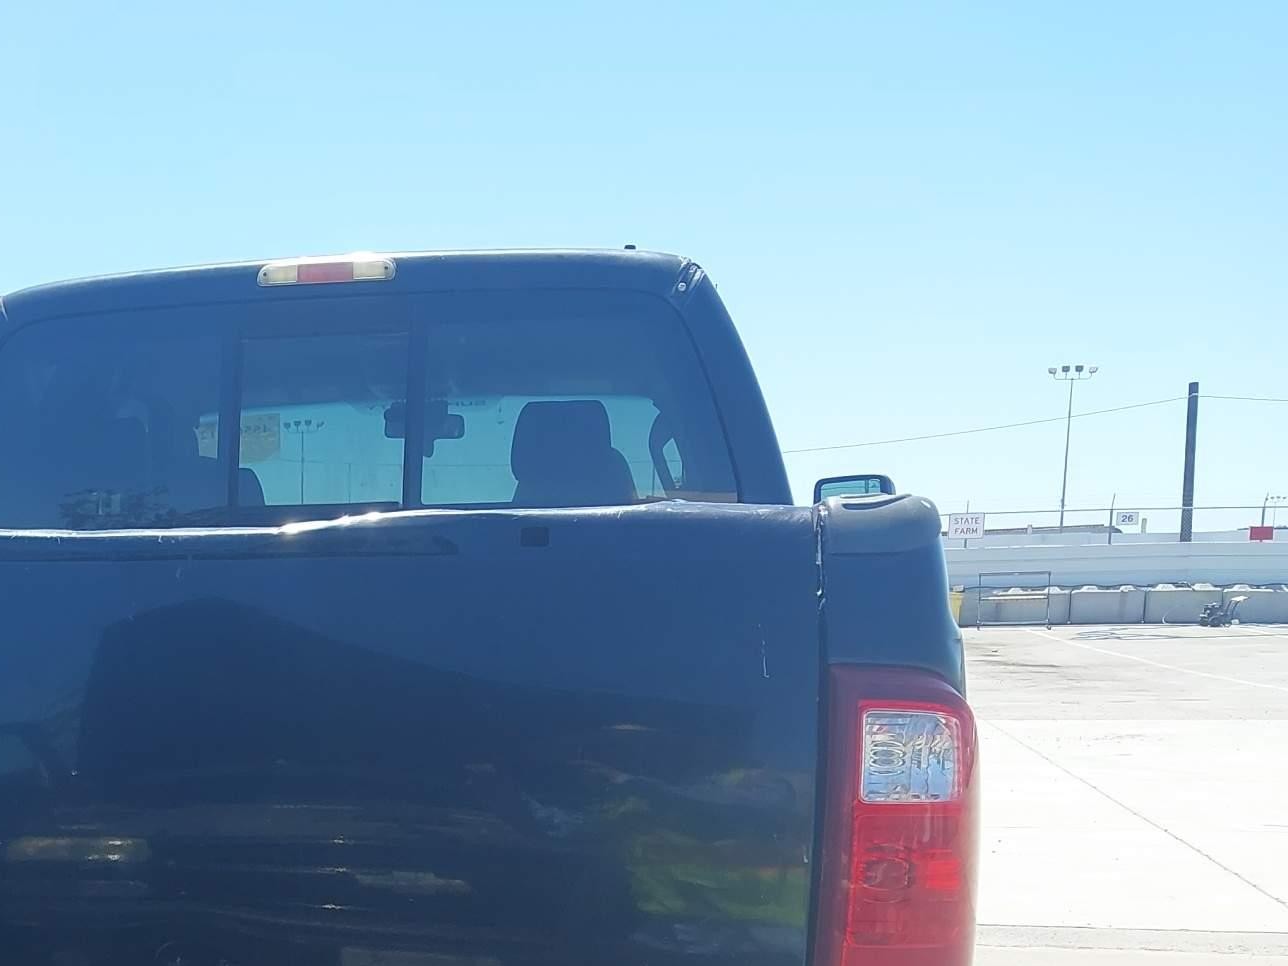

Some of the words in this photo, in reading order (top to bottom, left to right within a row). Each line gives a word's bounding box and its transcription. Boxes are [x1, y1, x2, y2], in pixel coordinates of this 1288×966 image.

[954, 517, 980, 526] STATE
[1121, 514, 1134, 523] 26
[954, 527, 978, 536] FARM
